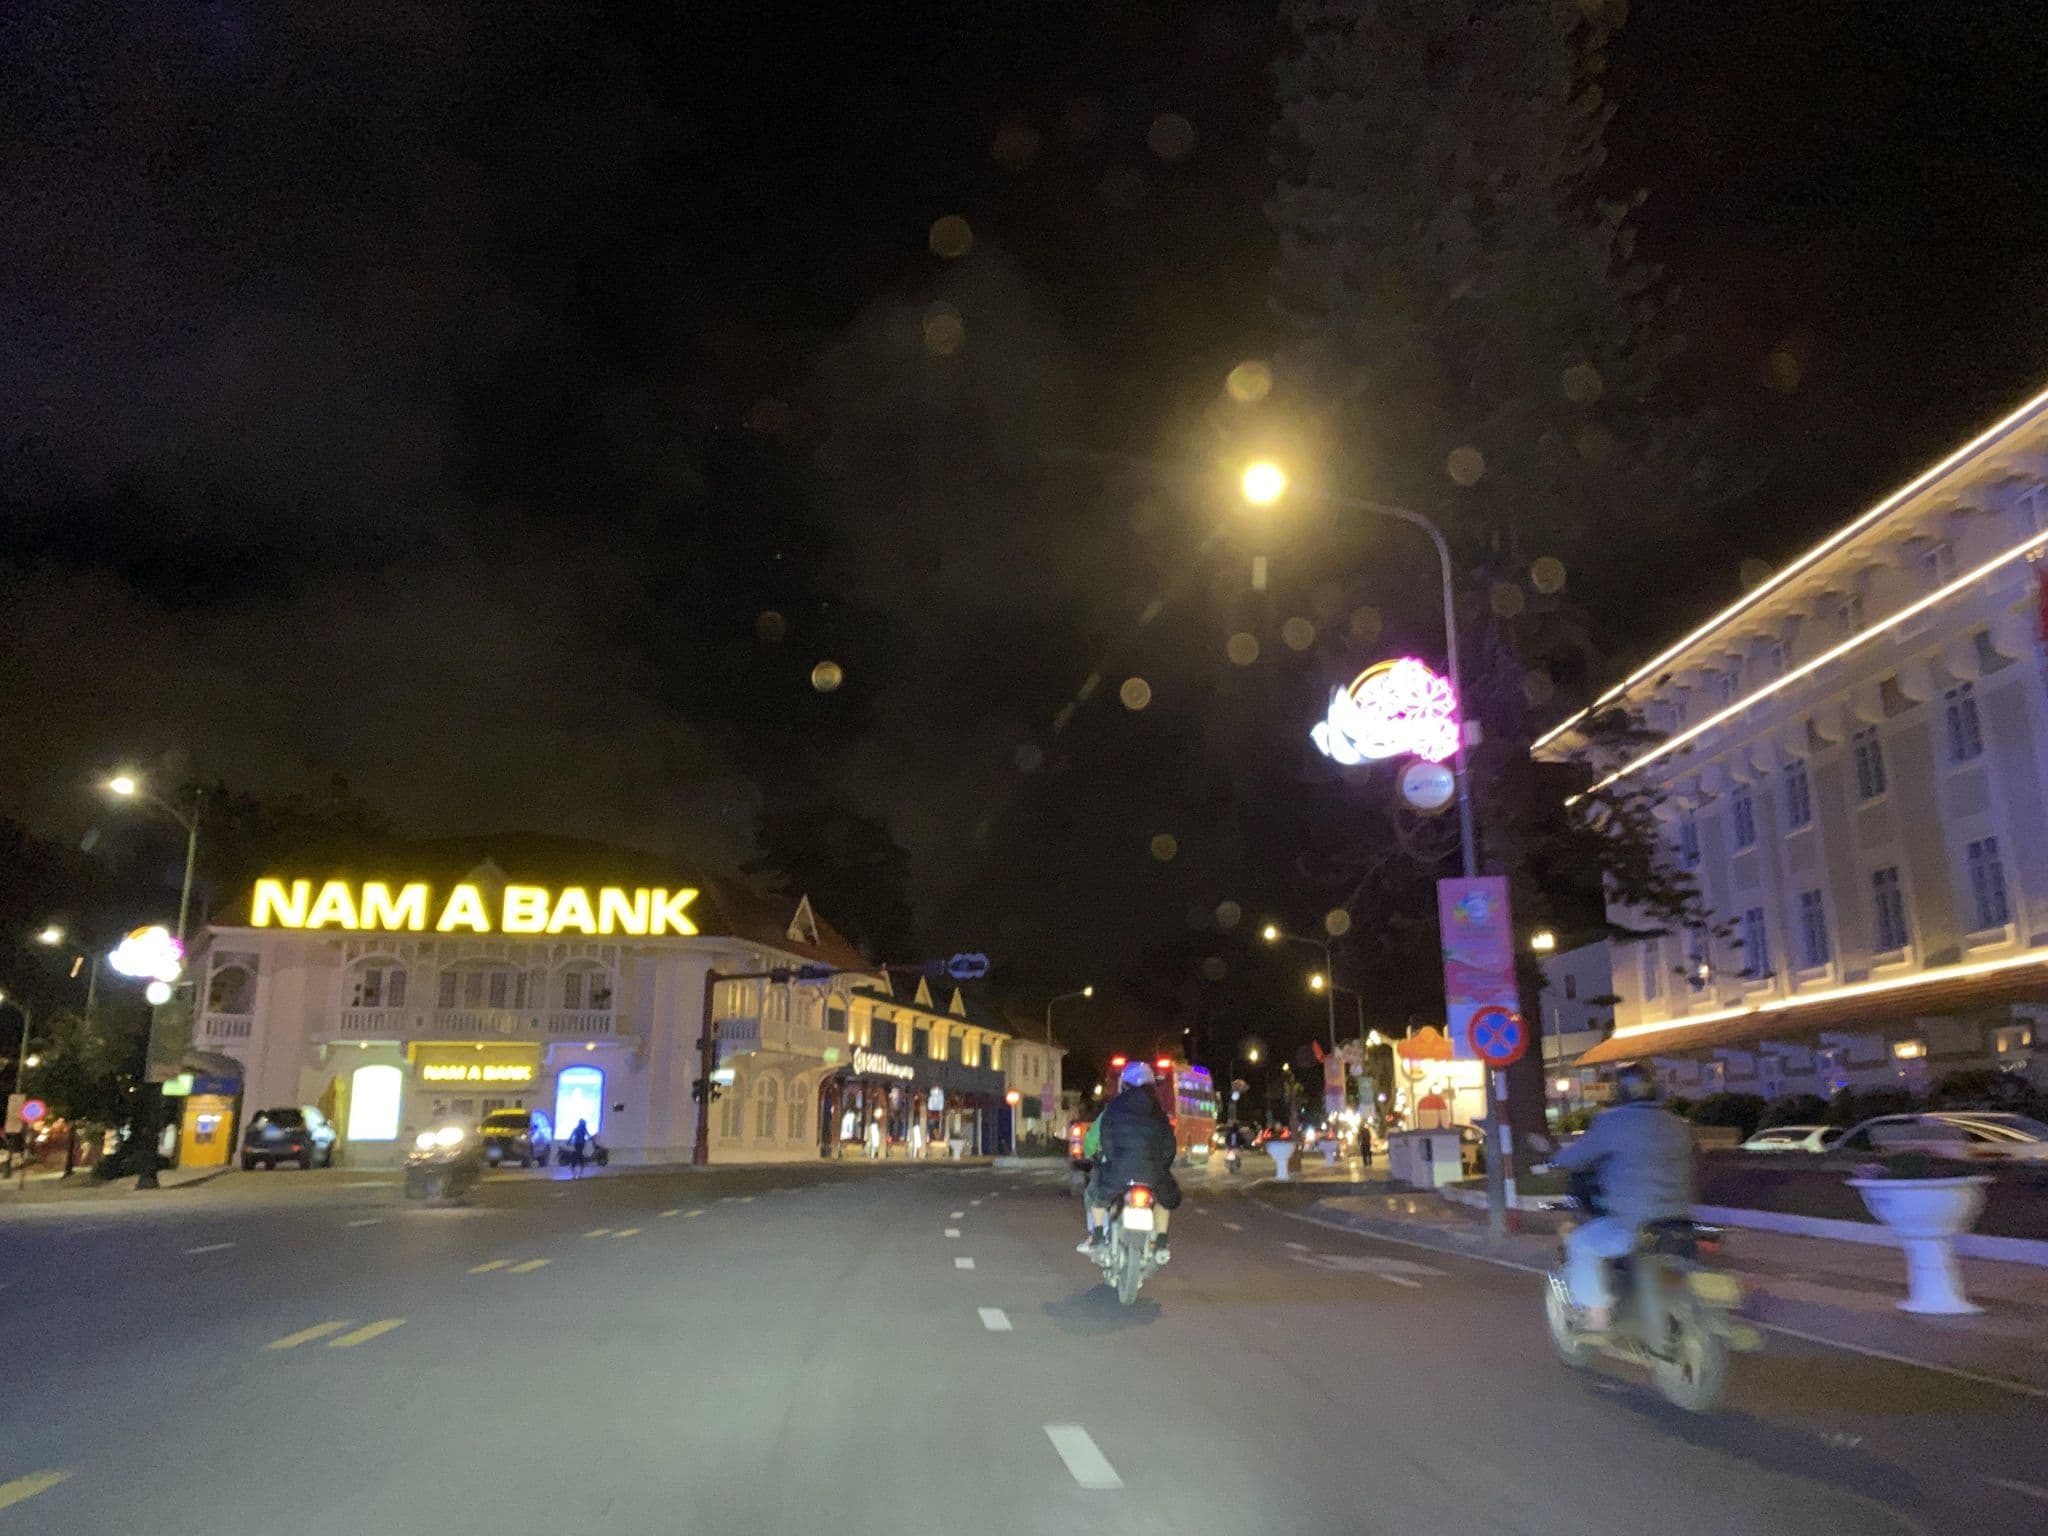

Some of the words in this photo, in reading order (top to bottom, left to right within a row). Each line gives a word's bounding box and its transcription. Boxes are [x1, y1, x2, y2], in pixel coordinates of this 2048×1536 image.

[251, 879, 428, 931] NAM
[436, 884, 490, 933] A
[502, 885, 699, 936] BANK
